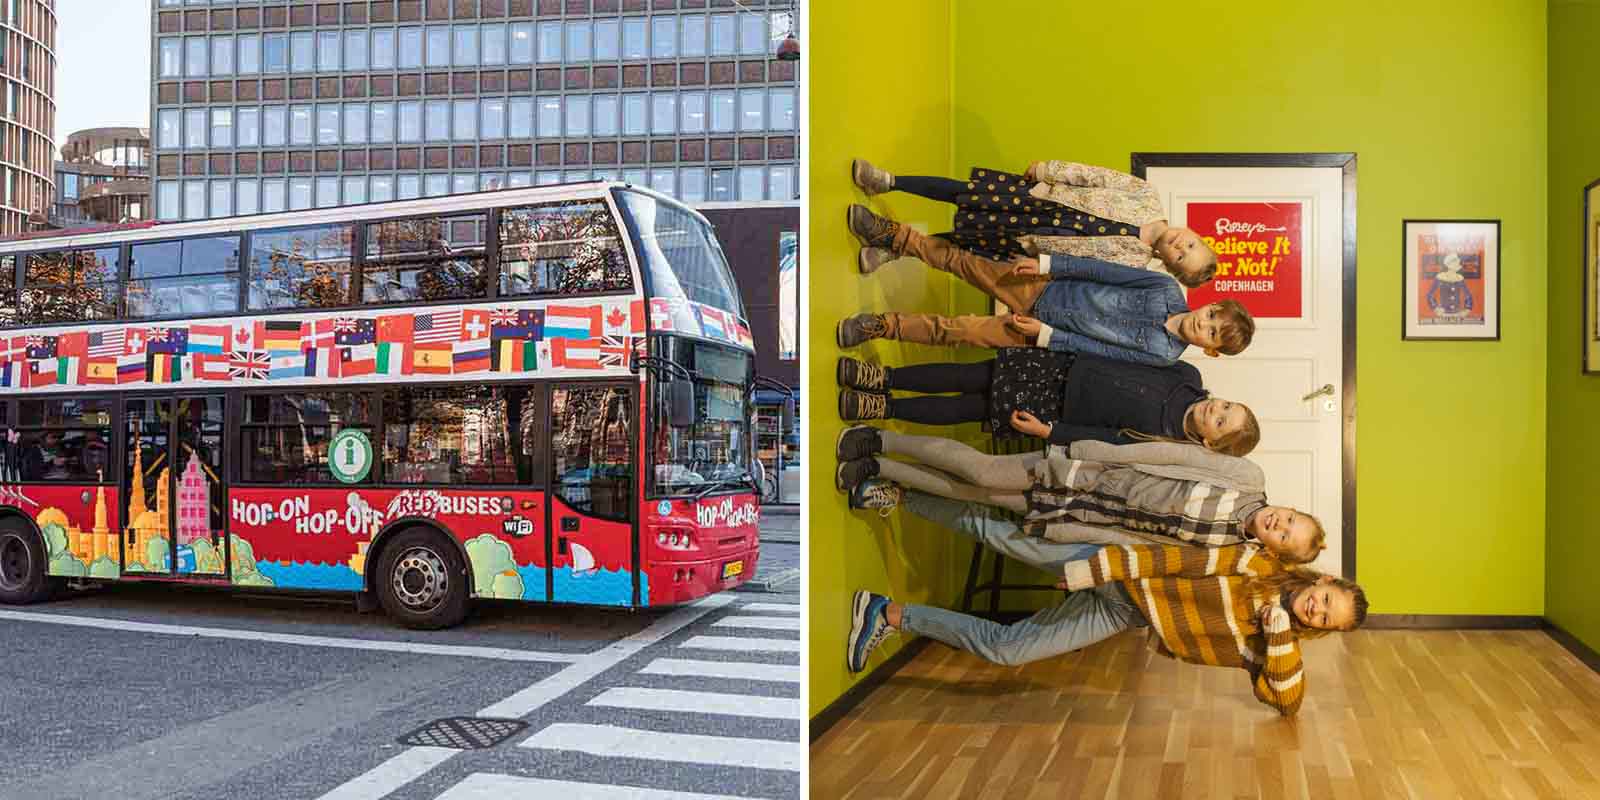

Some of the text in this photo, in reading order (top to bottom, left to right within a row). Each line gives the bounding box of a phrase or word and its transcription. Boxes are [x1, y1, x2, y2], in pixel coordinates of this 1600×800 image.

[1272, 236, 1291, 255] It
[1235, 256, 1278, 276] Not!
[1215, 280, 1274, 292] COPENHAGEN
[232, 495, 309, 526] HOP-ON
[440, 496, 502, 515] BUSES
[696, 496, 733, 528] HOP-ON
